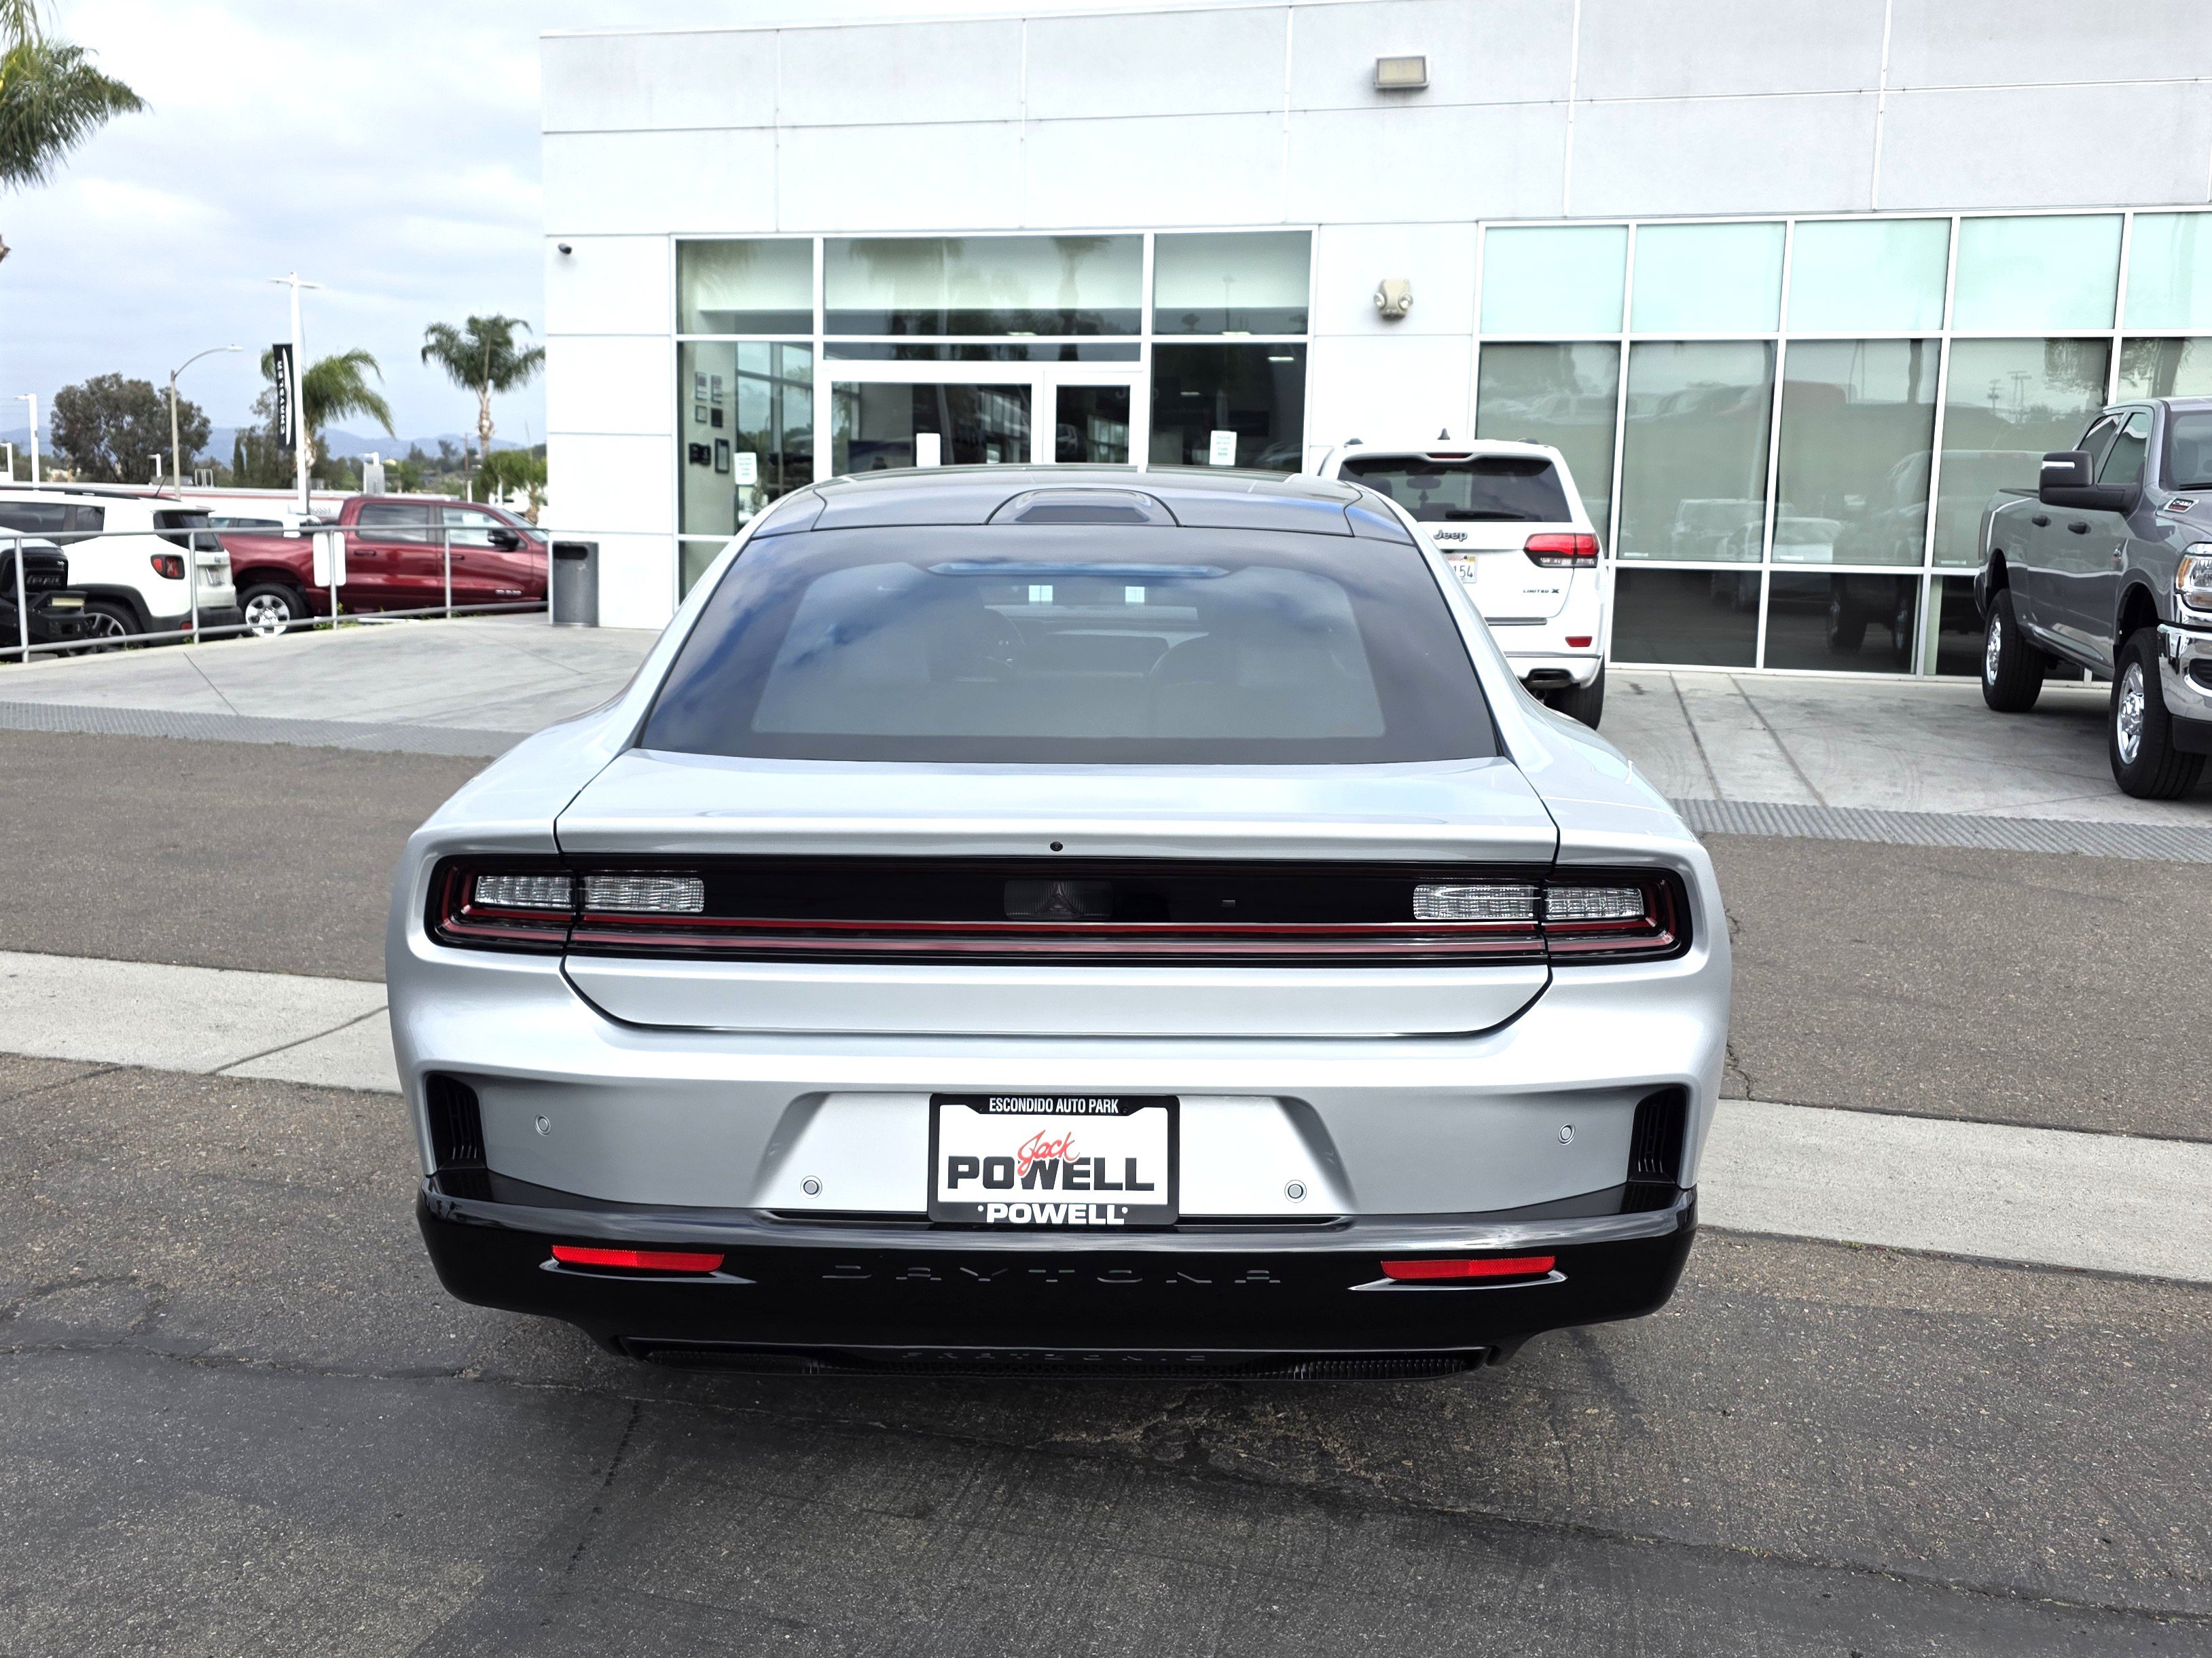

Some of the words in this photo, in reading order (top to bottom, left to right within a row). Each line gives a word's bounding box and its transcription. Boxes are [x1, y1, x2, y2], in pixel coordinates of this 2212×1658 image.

[276, 360, 286, 435] CHRYSLER
[1433, 529, 1468, 542] Jeep
[989, 1097, 1053, 1113] ESCONDIDO
[1055, 1098, 1087, 1113] AUTO
[1089, 1098, 1119, 1113] PARK
[1017, 1129, 1081, 1177] Jack
[947, 1155, 1155, 1192] POWELL
[986, 1203, 1125, 1226] POWELL
[822, 1265, 1281, 1284] DAYTONA
